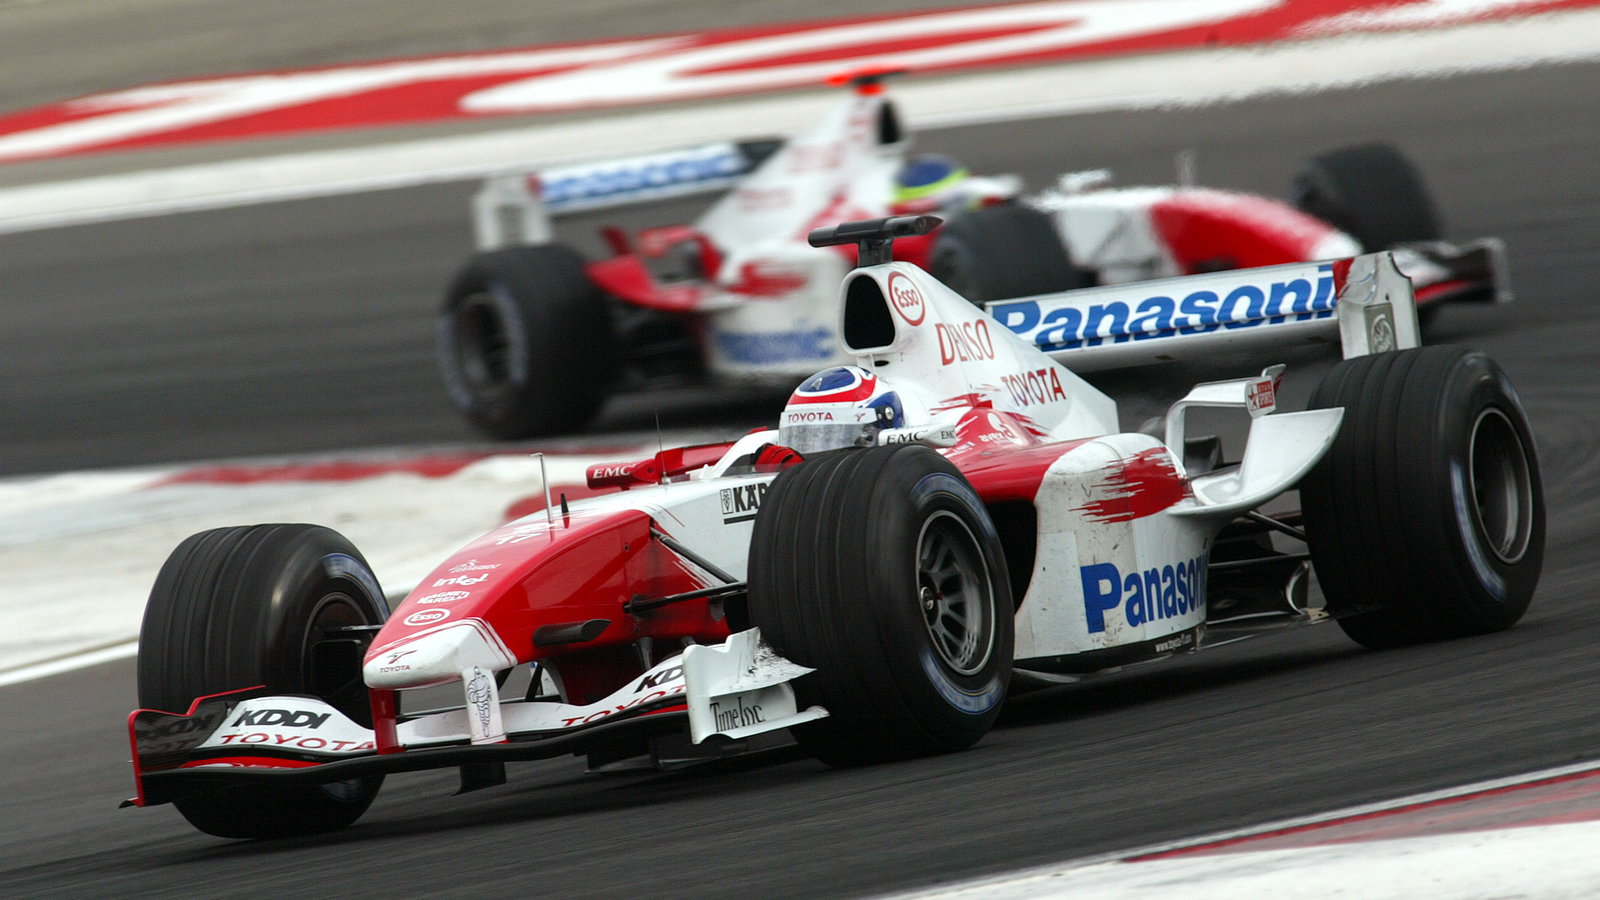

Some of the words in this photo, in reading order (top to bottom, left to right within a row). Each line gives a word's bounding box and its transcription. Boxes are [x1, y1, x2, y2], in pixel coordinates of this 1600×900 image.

[893, 286, 920, 309] Esso
[991, 263, 1337, 352] Panasoni
[934, 318, 996, 366] DENSO
[1000, 366, 1067, 408] TOYOTA
[787, 411, 834, 424] TOYOTA
[380, 664, 411, 673] TOYOTA
[232, 709, 331, 729] KDDI
[220, 732, 375, 751] TOYOTA
